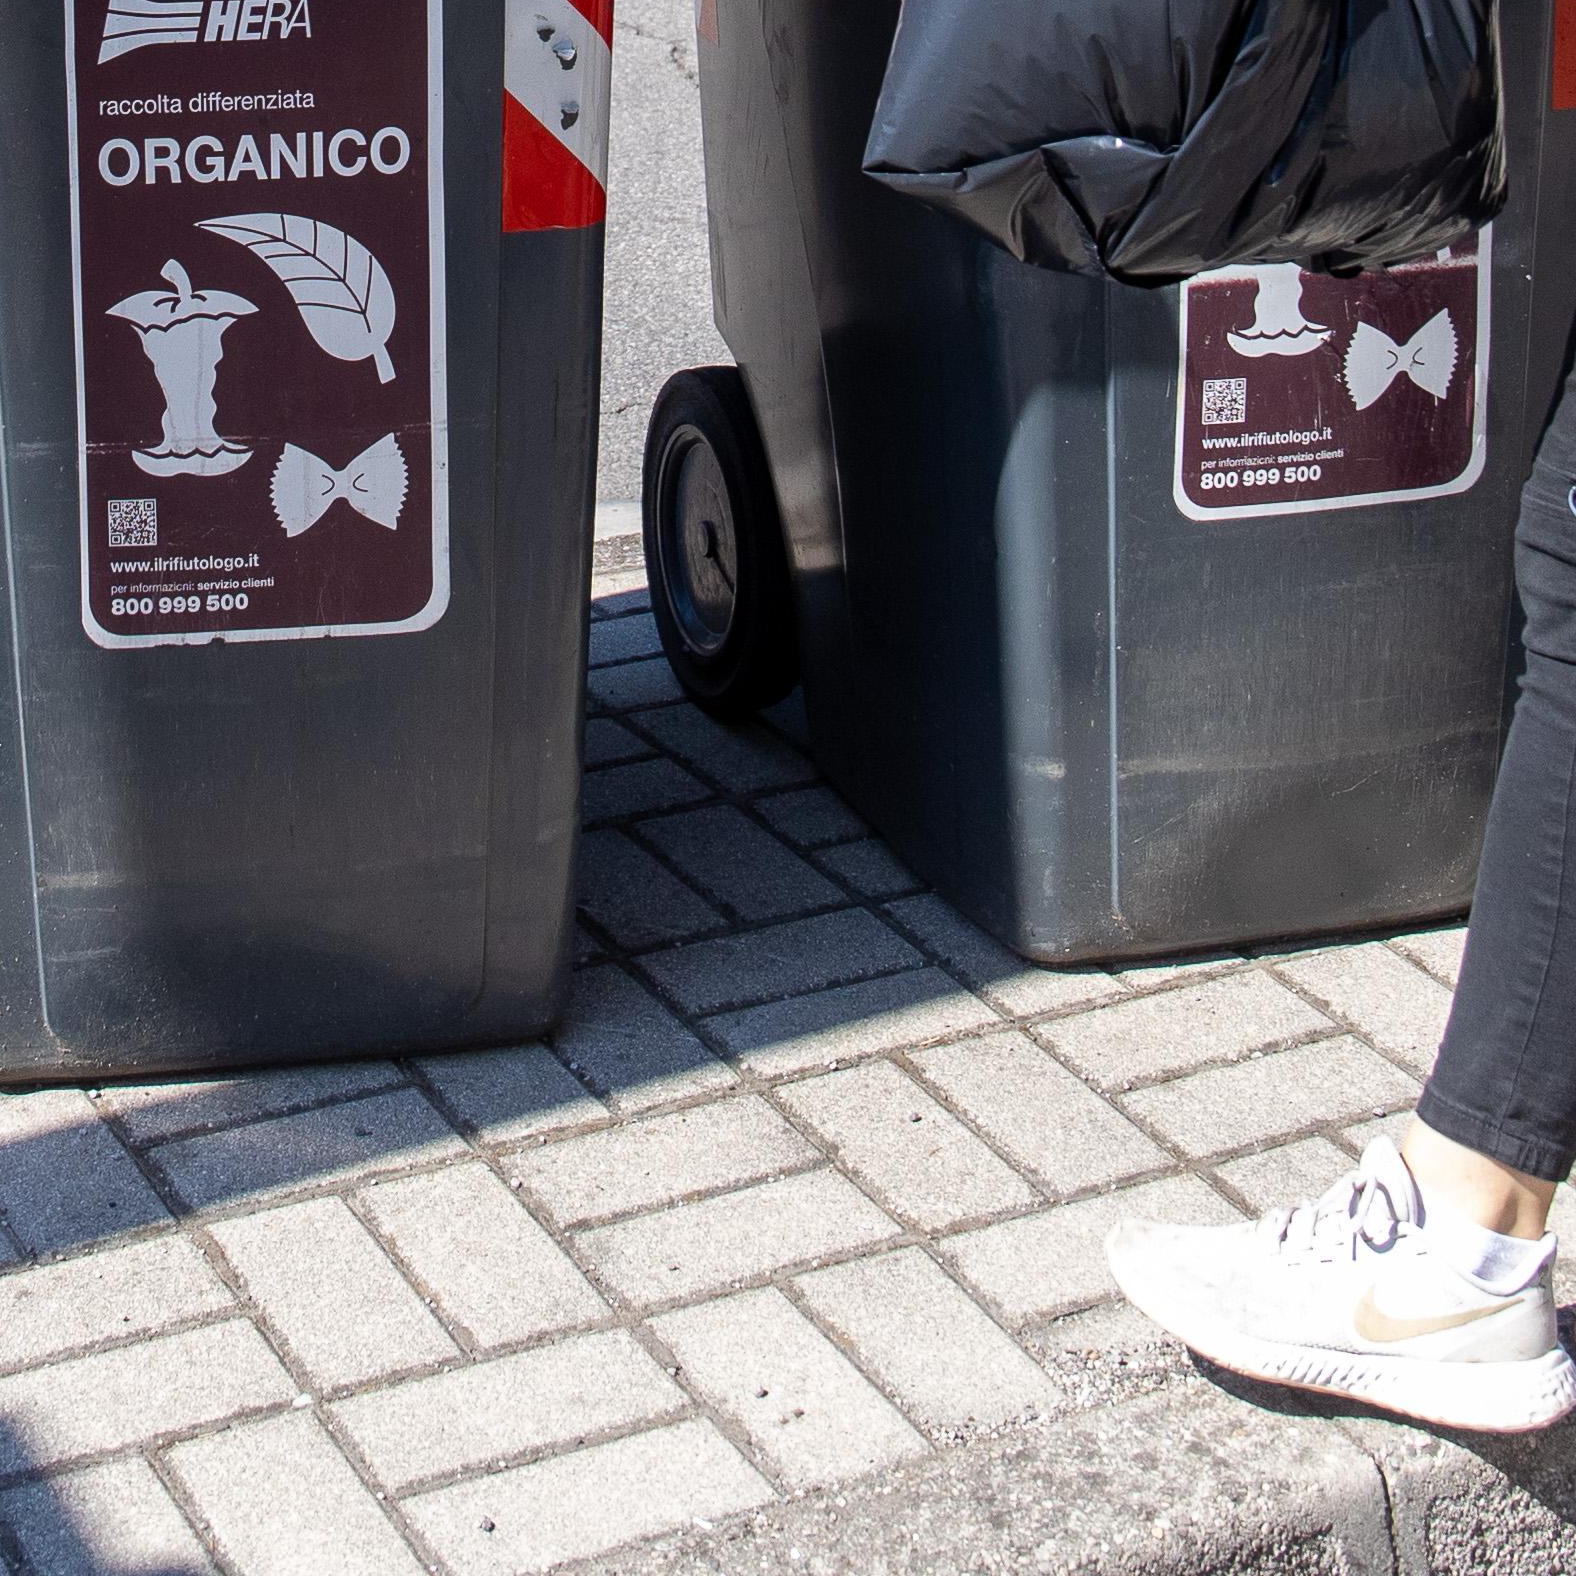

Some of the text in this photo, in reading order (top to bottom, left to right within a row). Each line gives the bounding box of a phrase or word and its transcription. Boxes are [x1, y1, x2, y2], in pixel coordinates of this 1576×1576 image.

[99, 89, 314, 115] raccolta differenziata
[98, 126, 410, 186] ORGANICO
[1202, 427, 1332, 449] www.ilrifiutologo.it
[1201, 460, 1217, 471] per
[1277, 452, 1314, 464] servizio
[1315, 448, 1344, 460] clienti
[1200, 465, 1322, 489] 800 999 500
[111, 553, 260, 573] www.ilrifiutologo.it
[111, 585, 127, 596] per
[197, 579, 239, 591] servizio
[242, 577, 274, 588] clienti
[111, 593, 249, 615] 800 999 500
